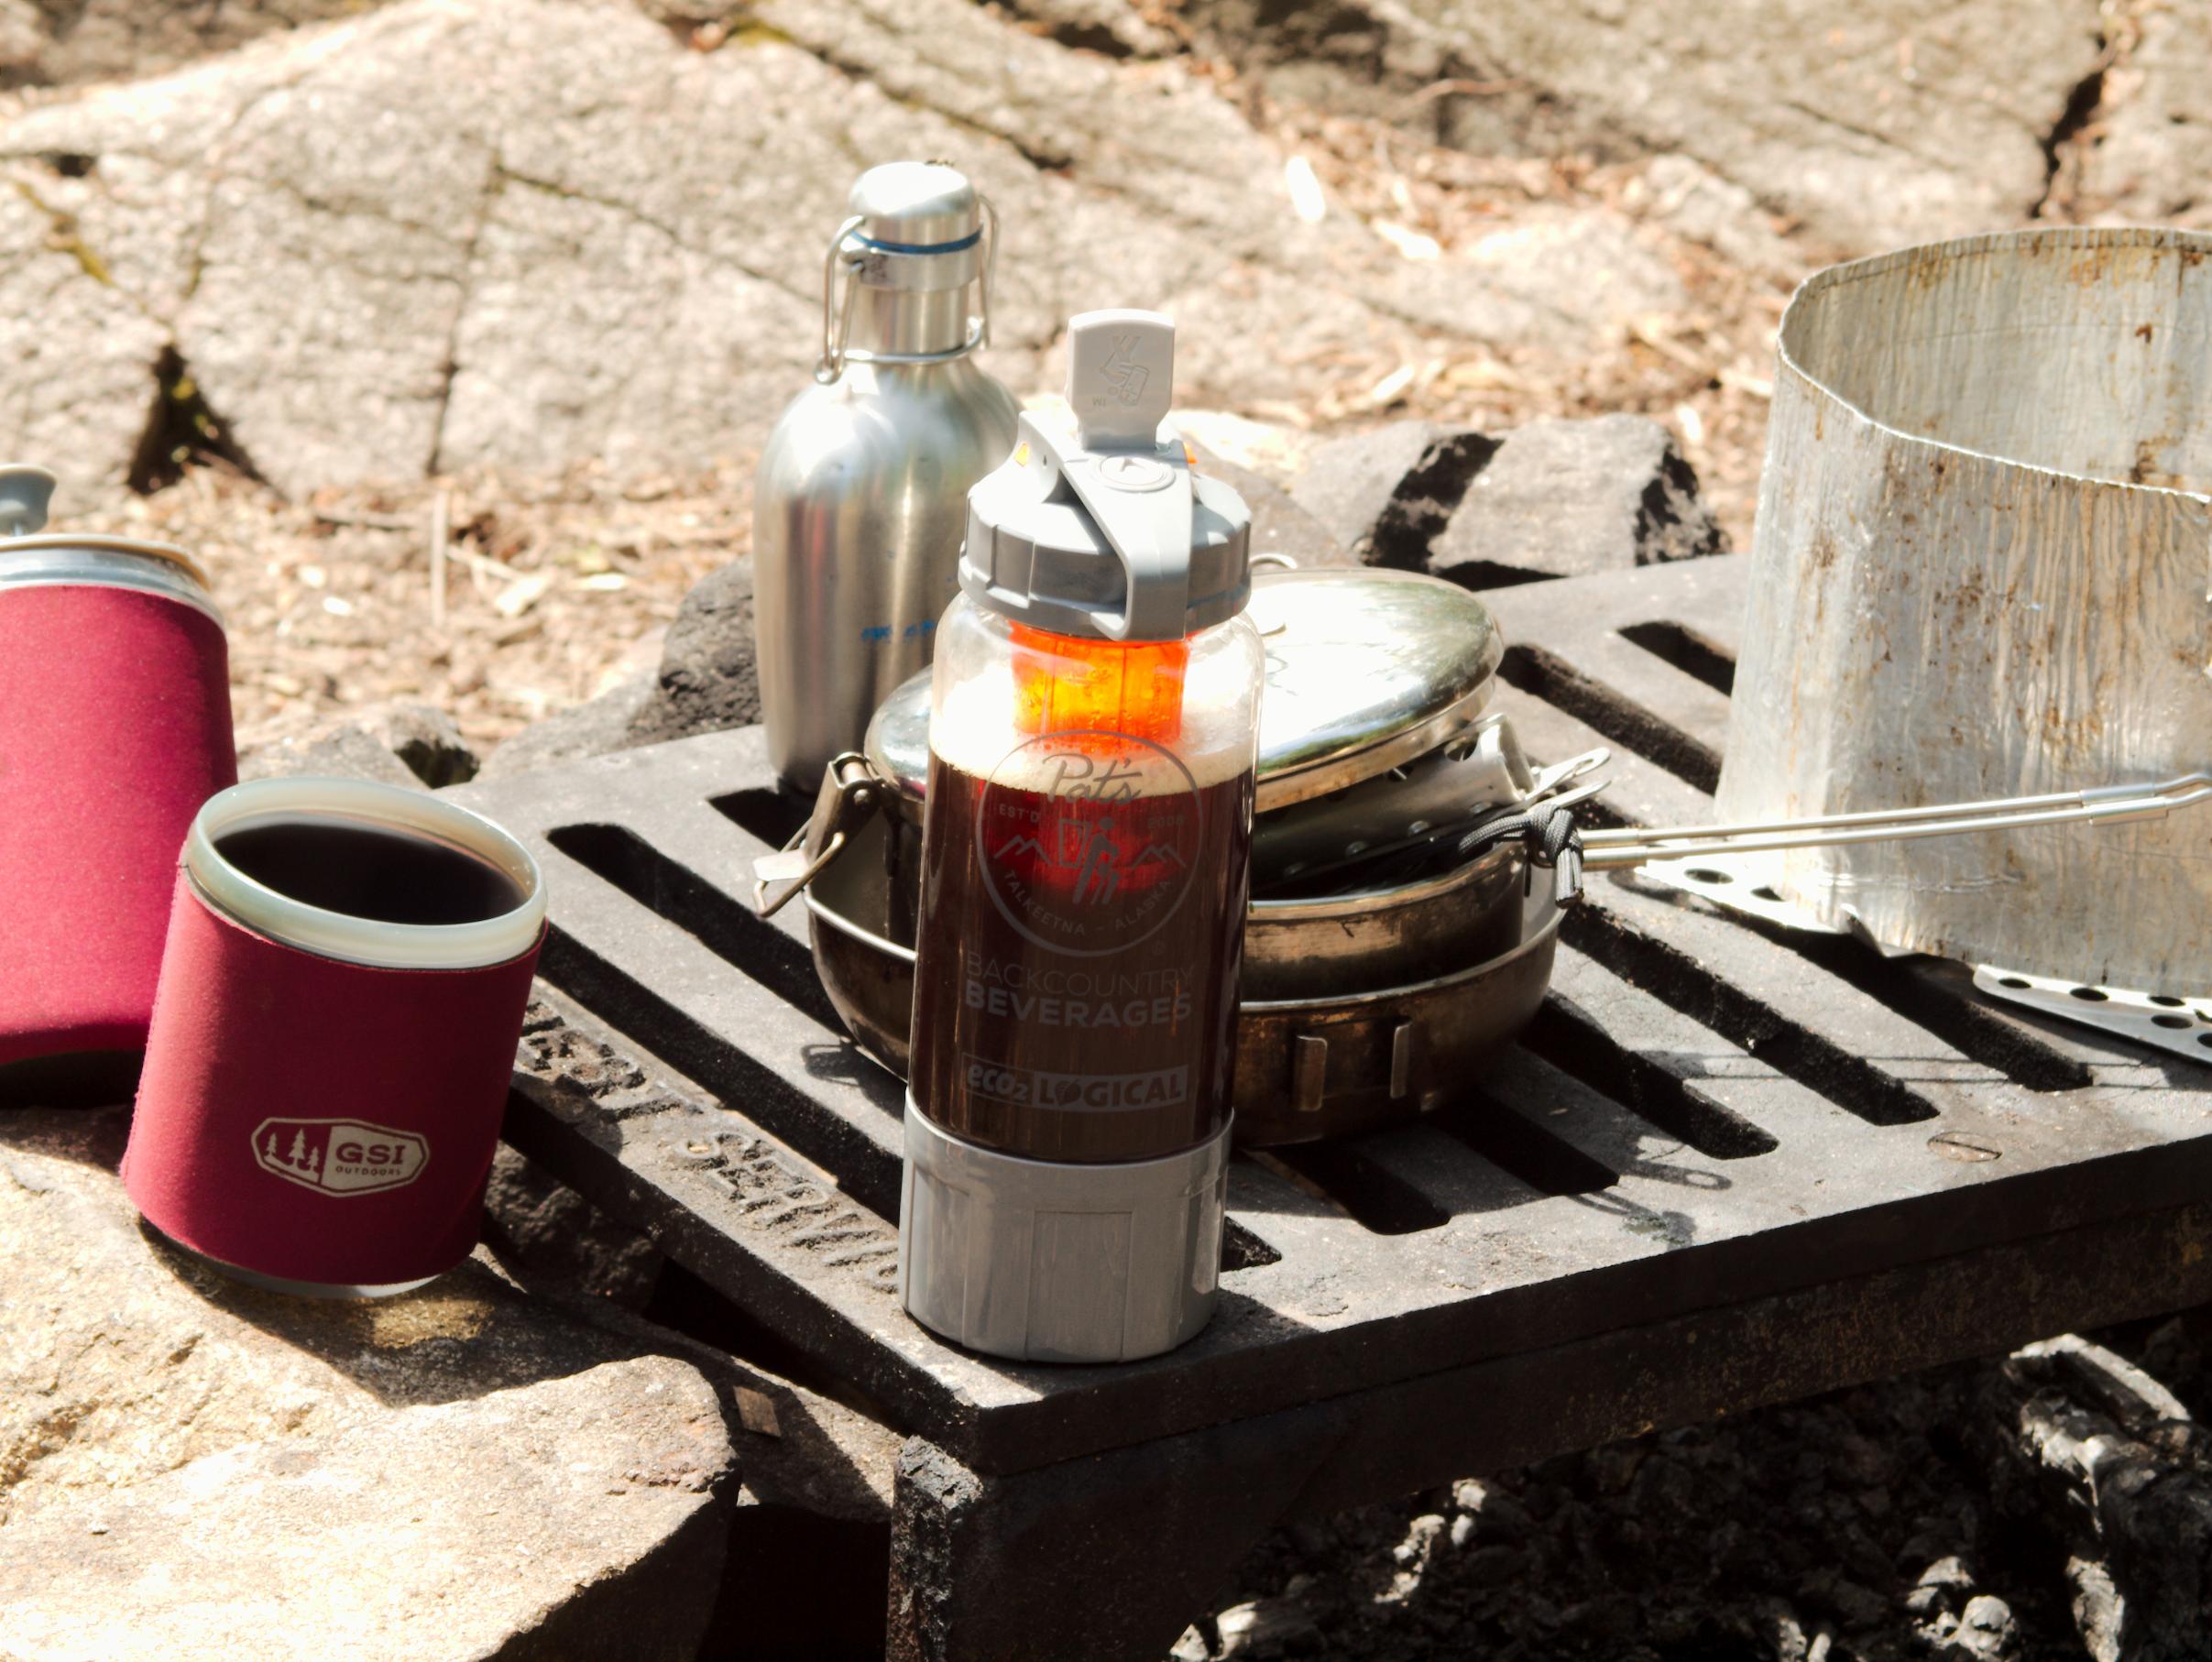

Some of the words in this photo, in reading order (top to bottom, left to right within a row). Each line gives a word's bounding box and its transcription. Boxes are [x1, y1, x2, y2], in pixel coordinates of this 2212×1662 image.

[1043, 753, 1143, 805] Pat's
[1004, 869, 1085, 935] TALKEETNA
[1115, 880, 1170, 931] ALASKA
[967, 949, 1194, 997] BACKCOUNTRY
[965, 979, 1191, 1027] BEVERAGES
[335, 1143, 406, 1165] GSI
[335, 1165, 401, 1176] OUTDOORS
